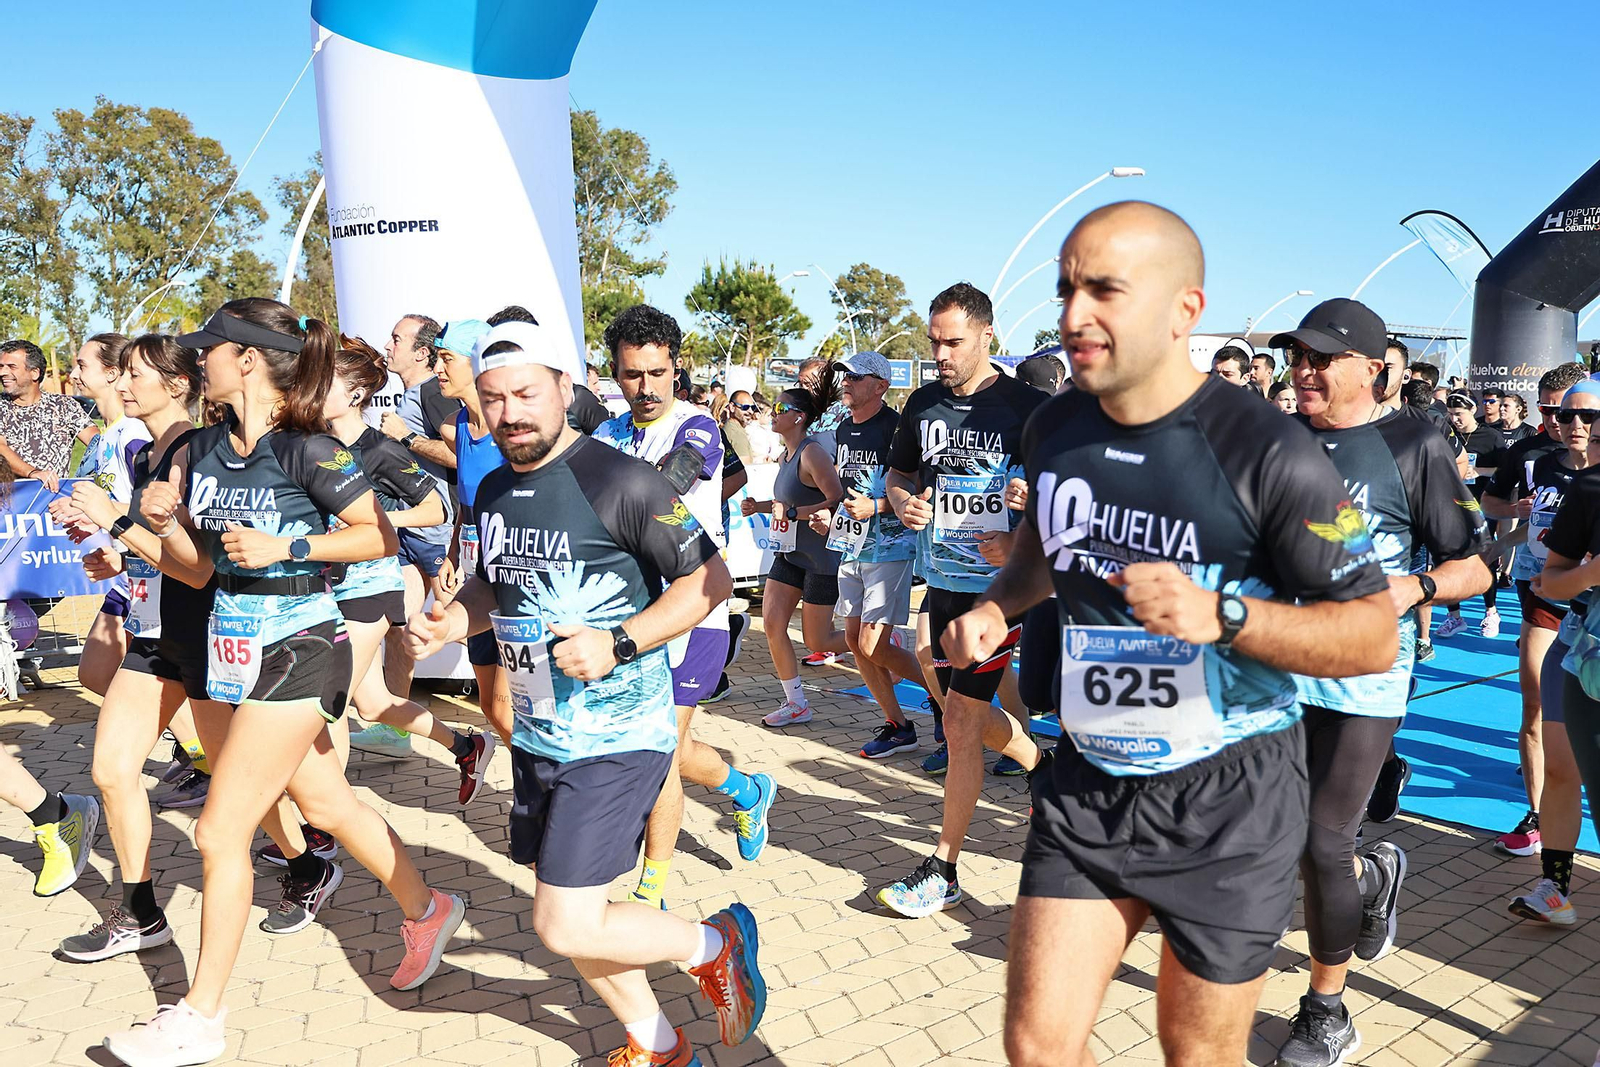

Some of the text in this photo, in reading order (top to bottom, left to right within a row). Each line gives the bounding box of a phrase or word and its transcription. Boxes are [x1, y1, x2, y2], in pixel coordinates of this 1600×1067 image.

[332, 219, 439, 240] ATLANTIC COPPER
[1470, 363, 1508, 376] Huelva
[946, 428, 1003, 453] HUELVA
[847, 450, 879, 465] HUELVA
[943, 457, 977, 470] AVATE
[209, 487, 278, 511] HUELVA
[940, 493, 1003, 515] 1066
[770, 519, 790, 533] 09
[835, 516, 862, 536] 919
[1088, 501, 1200, 562] HUELVA
[461, 541, 480, 561] 77
[501, 527, 572, 561] HUELVA
[21, 546, 82, 568] syrluz
[499, 568, 536, 588] AVATE
[213, 637, 252, 666] 185
[1118, 638, 1162, 652] AVATEL
[1083, 665, 1179, 709] 625
[1090, 737, 1162, 756] Wayalia
